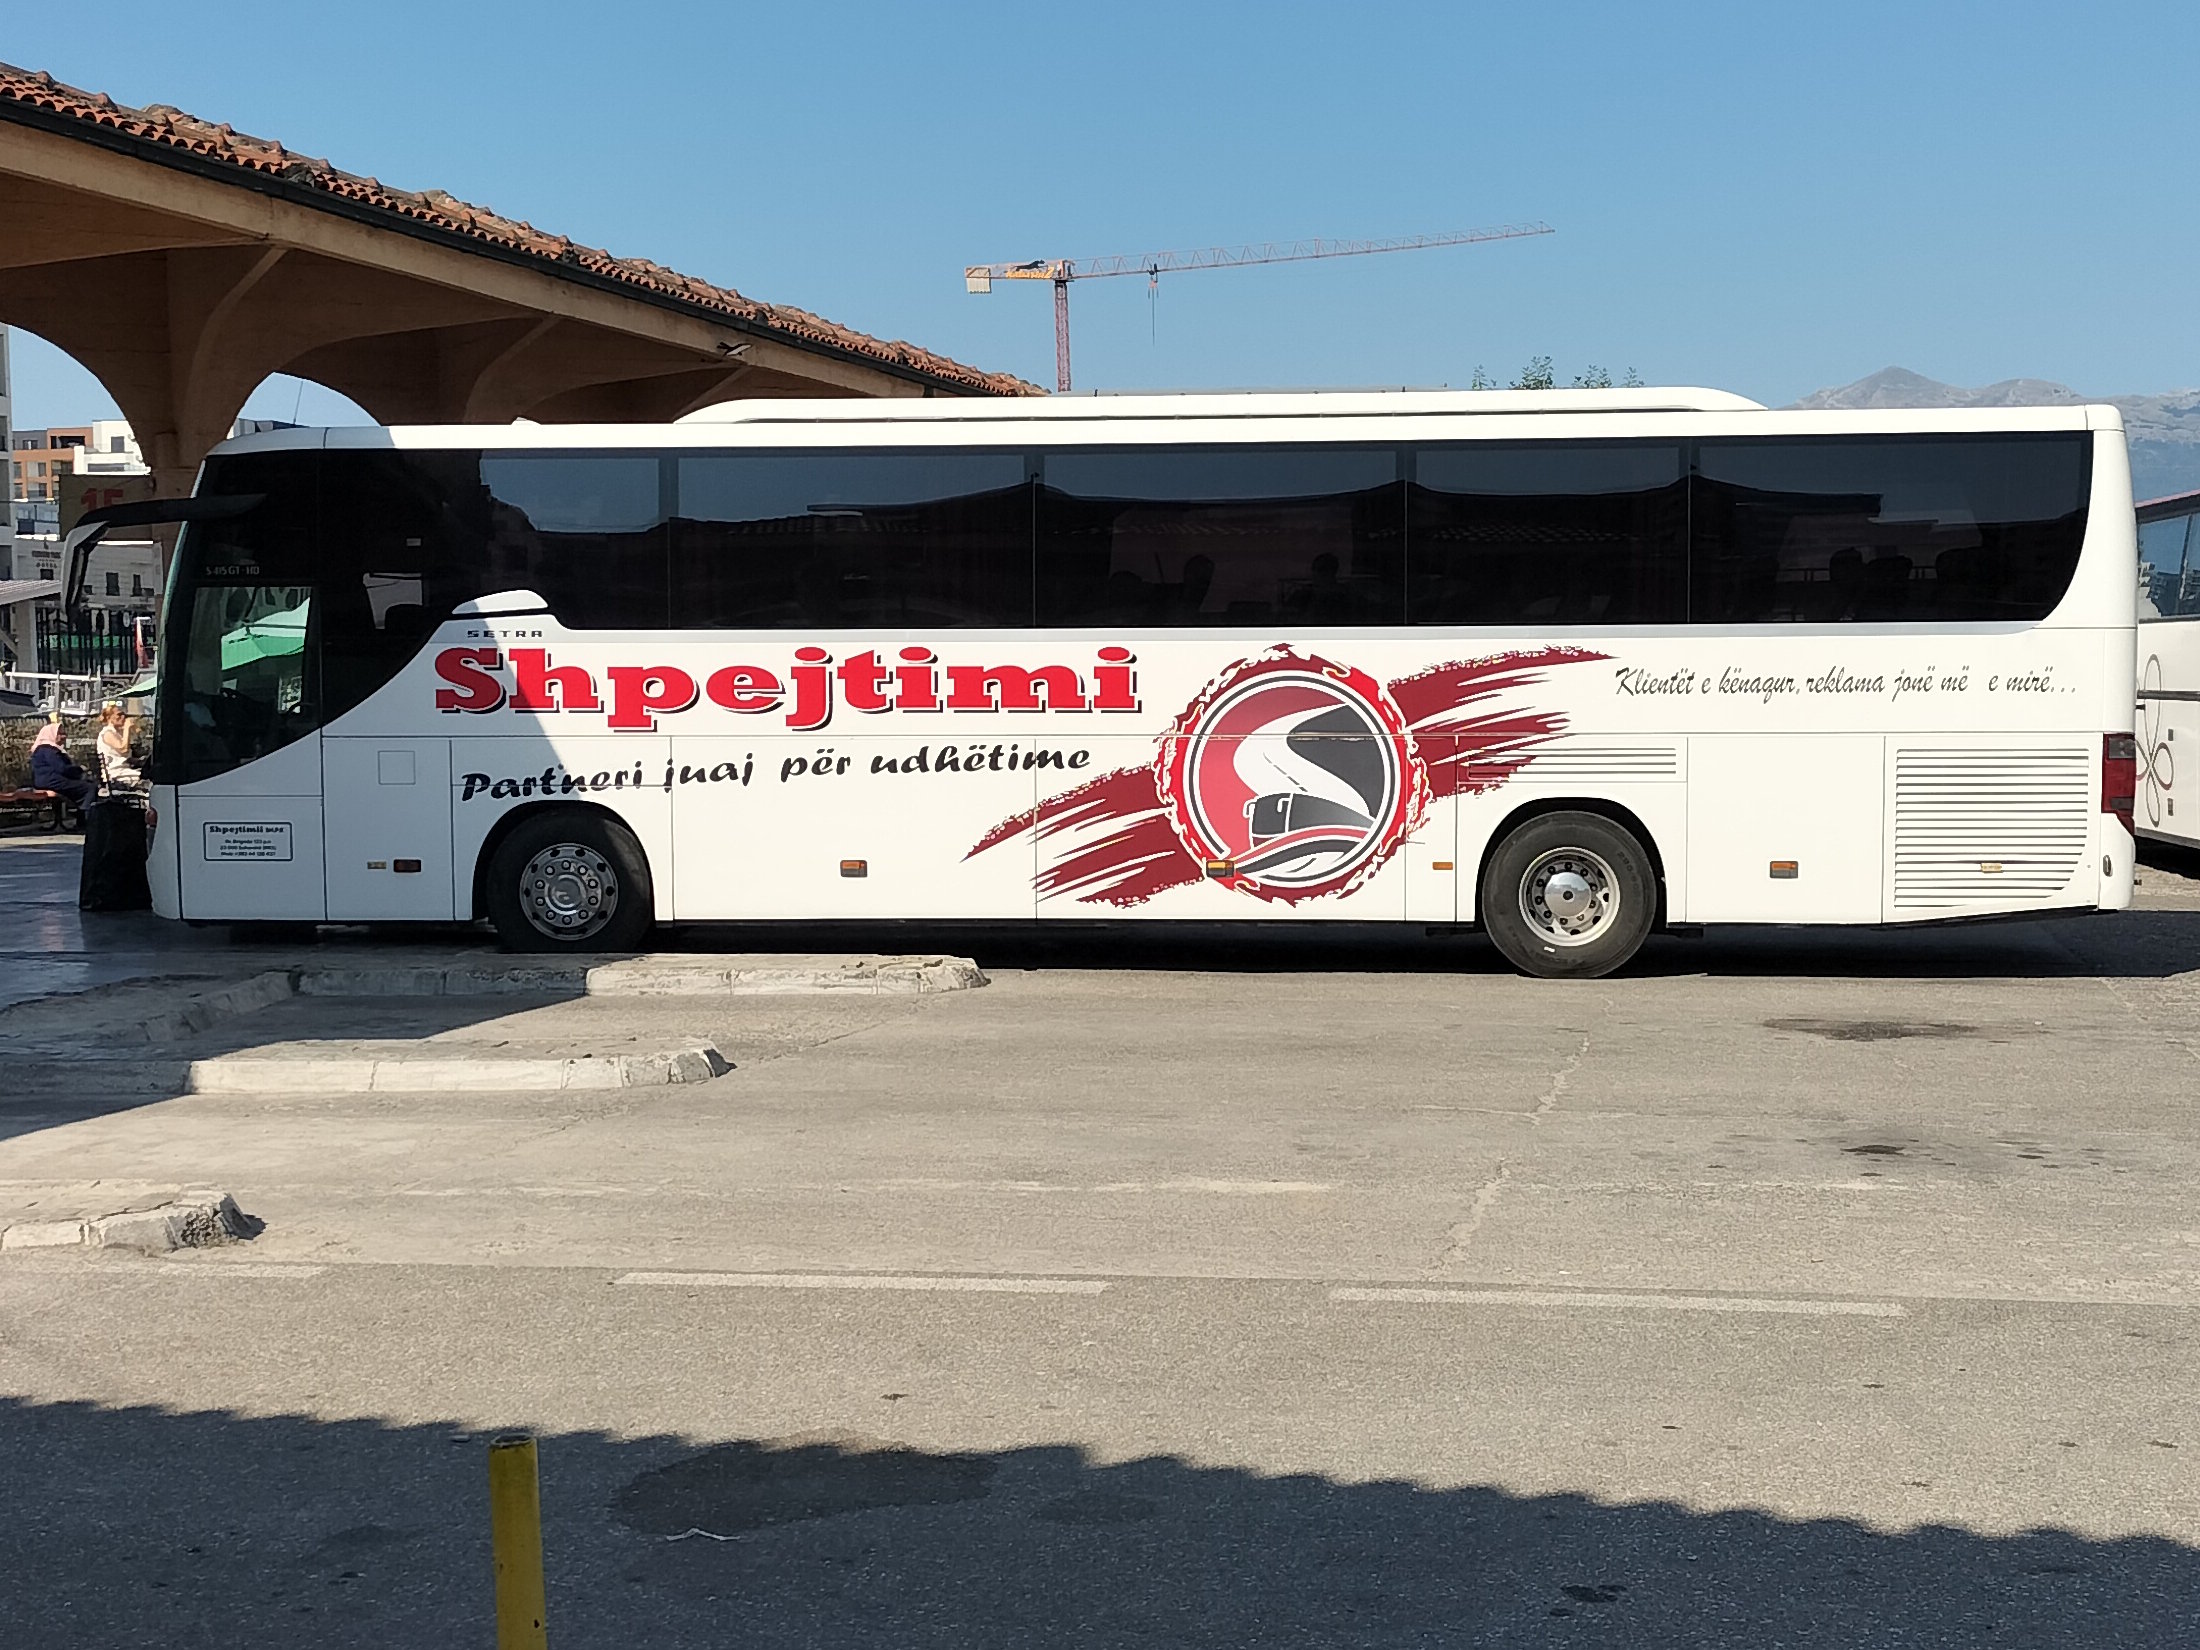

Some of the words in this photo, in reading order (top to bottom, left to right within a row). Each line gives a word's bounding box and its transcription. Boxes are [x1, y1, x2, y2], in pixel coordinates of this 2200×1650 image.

[467, 629, 542, 638] SETRA
[434, 646, 1142, 732] Shpejtimi
[1615, 666, 1696, 697] Klientët
[1701, 677, 1712, 695] e
[1806, 665, 1886, 694] reklama
[1890, 665, 1936, 703] jonë
[1940, 664, 1970, 692] më
[1988, 674, 1999, 692] e
[461, 760, 643, 802] Partneri
[661, 752, 754, 793] juaj
[780, 747, 852, 783] për
[869, 743, 1091, 774] udhëtime
